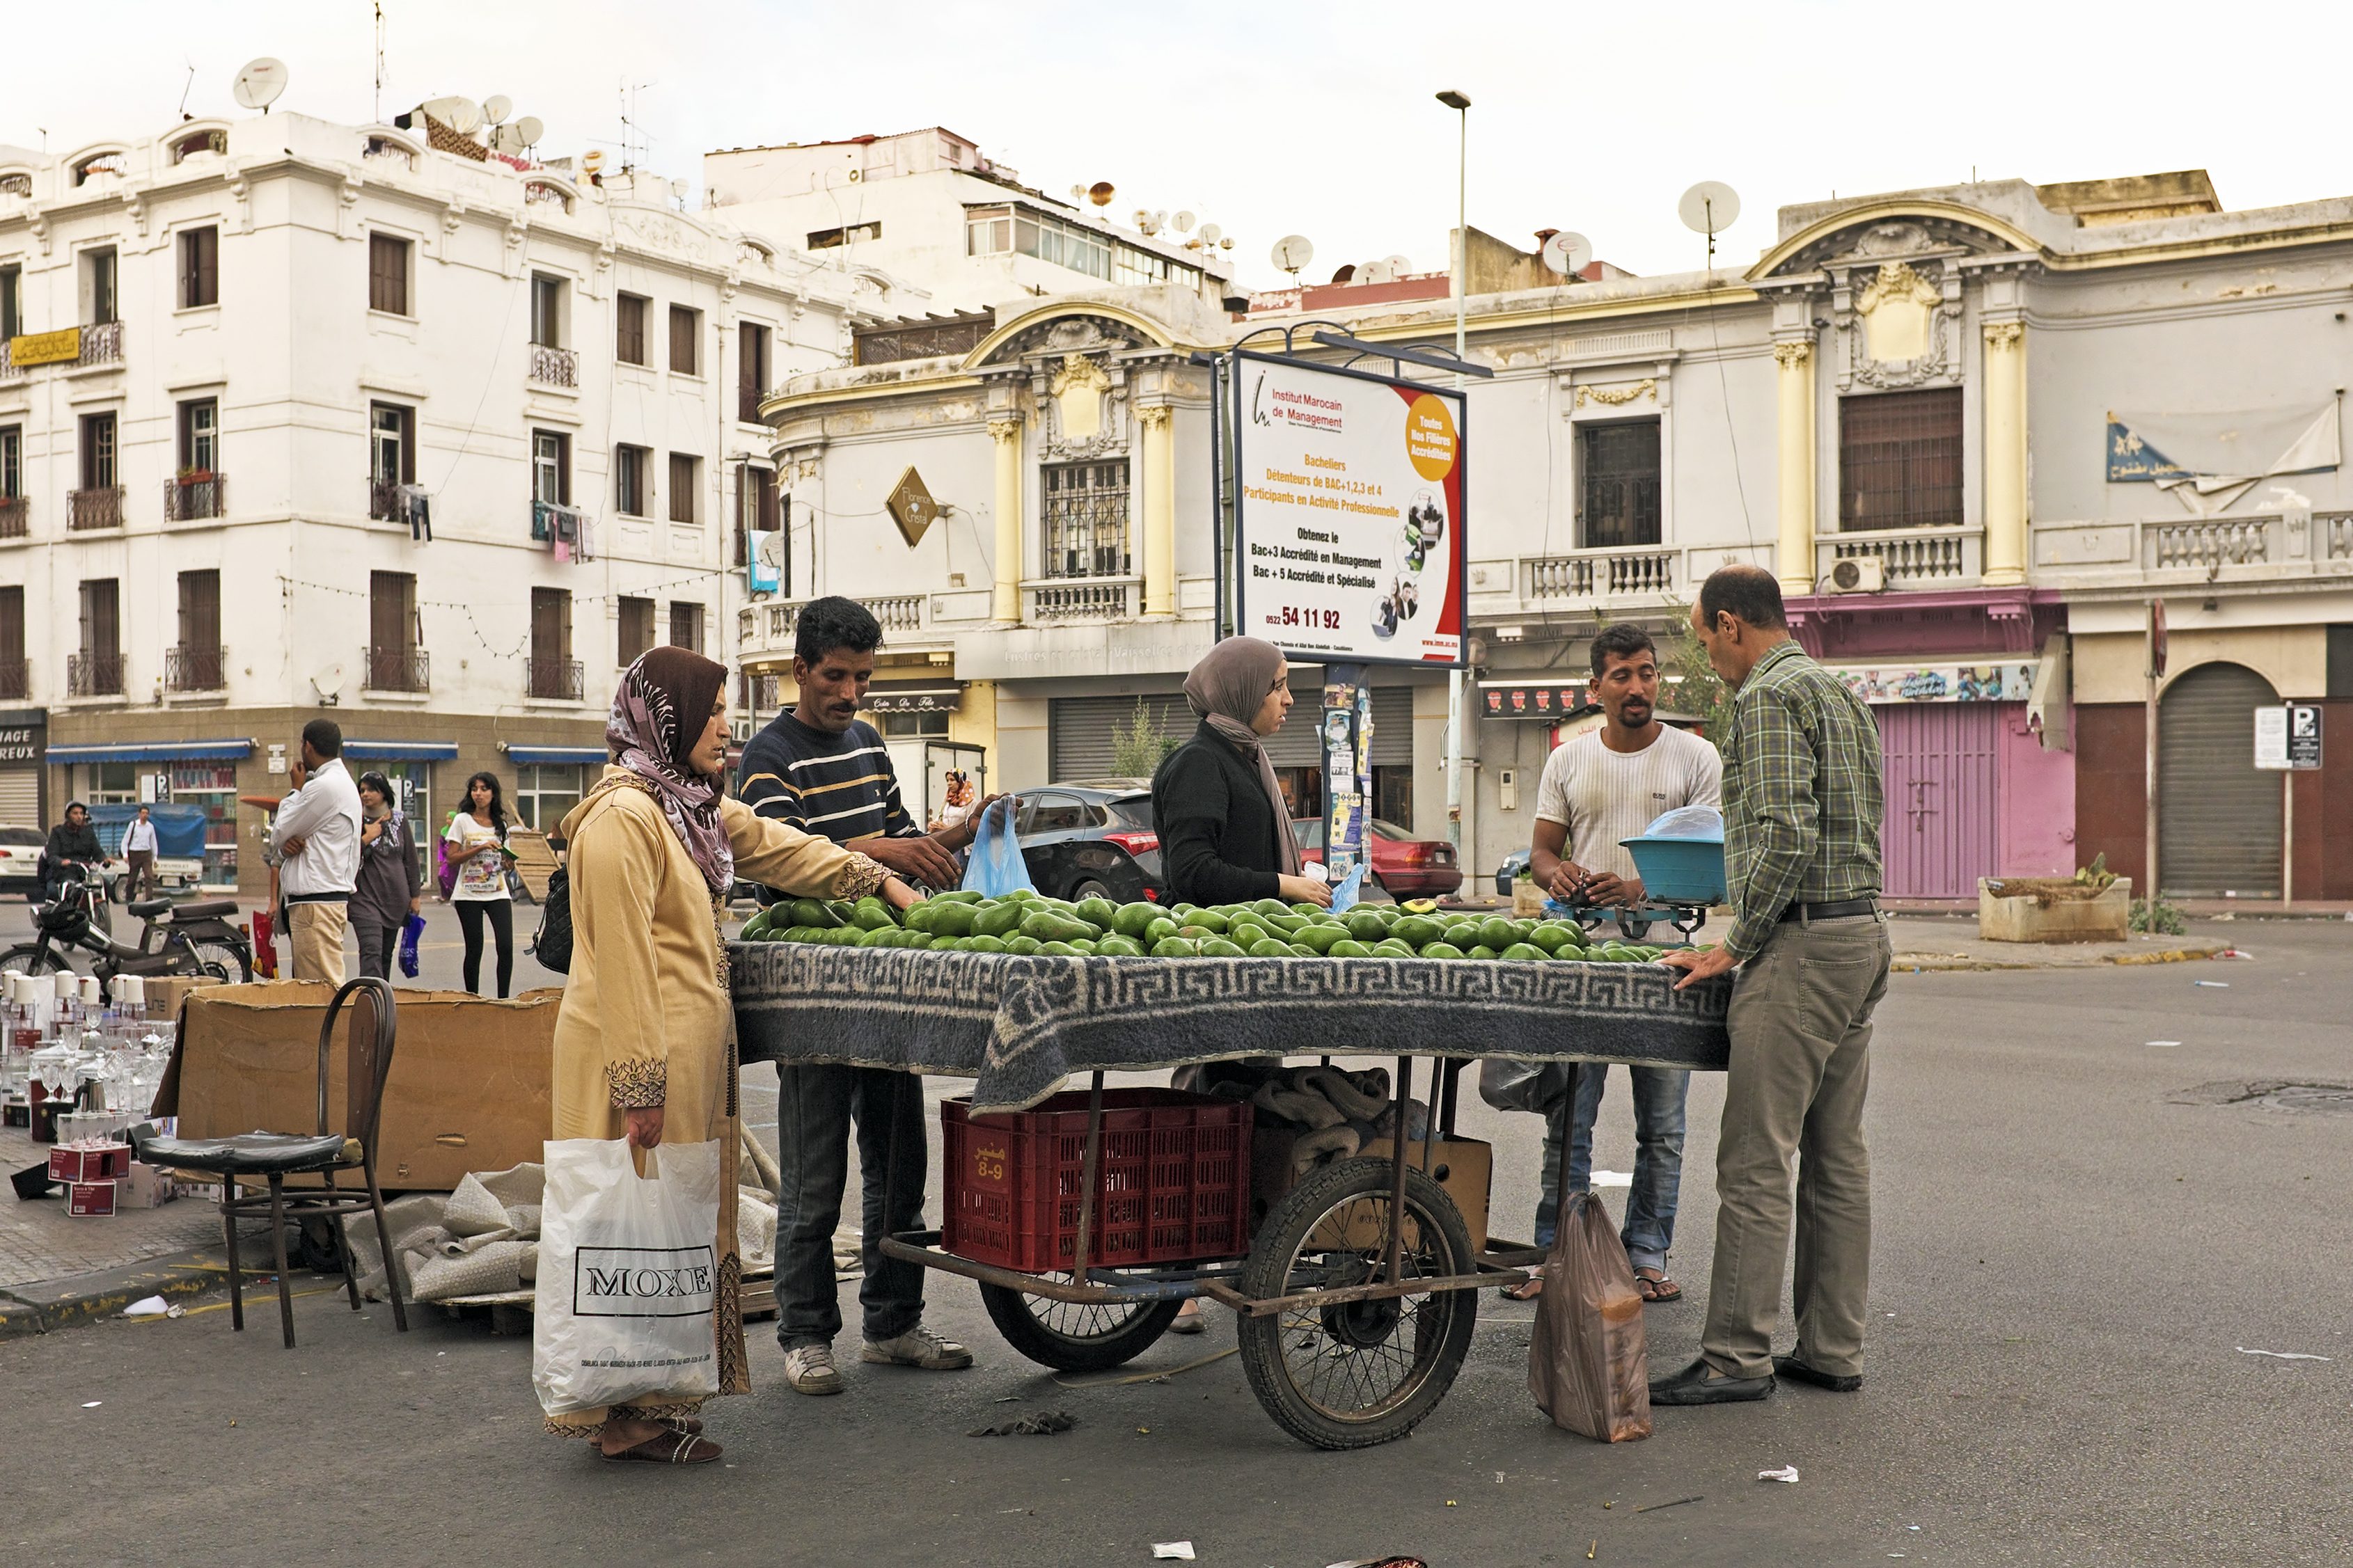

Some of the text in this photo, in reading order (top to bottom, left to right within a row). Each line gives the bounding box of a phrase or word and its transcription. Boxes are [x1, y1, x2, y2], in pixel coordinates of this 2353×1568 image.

[1273, 388, 1342, 411] Institut Marocain
[1273, 406, 1342, 428] de Management
[1419, 415, 1442, 430] Toutes
[1411, 429, 1451, 446] Nos Filières
[1411, 444, 1451, 461] Accréditées
[1305, 454, 1346, 472] Bacheliers
[1266, 468, 1382, 496] Détenteurs de BAC+1,2,3 et 4
[902, 487, 931, 505] Florence
[1244, 486, 1399, 518] Participants en Activité Professionnelle
[905, 505, 927, 525] Cristal
[1298, 527, 1338, 544] Obtenez le
[1252, 543, 1381, 569] Bac+3 Accrédité en Management
[1253, 564, 1376, 589] Bac + 5 Accrédité et Spécialisé
[1266, 606, 1339, 629] 0522 54 11 92
[1005, 648, 1046, 662] Lustres
[1114, 642, 1172, 658] Vaisselles
[899, 698, 910, 706] De
[2293, 708, 2314, 736] P
[978, 1162, 1002, 1180] 8-9
[585, 1266, 711, 1297] MOXE
